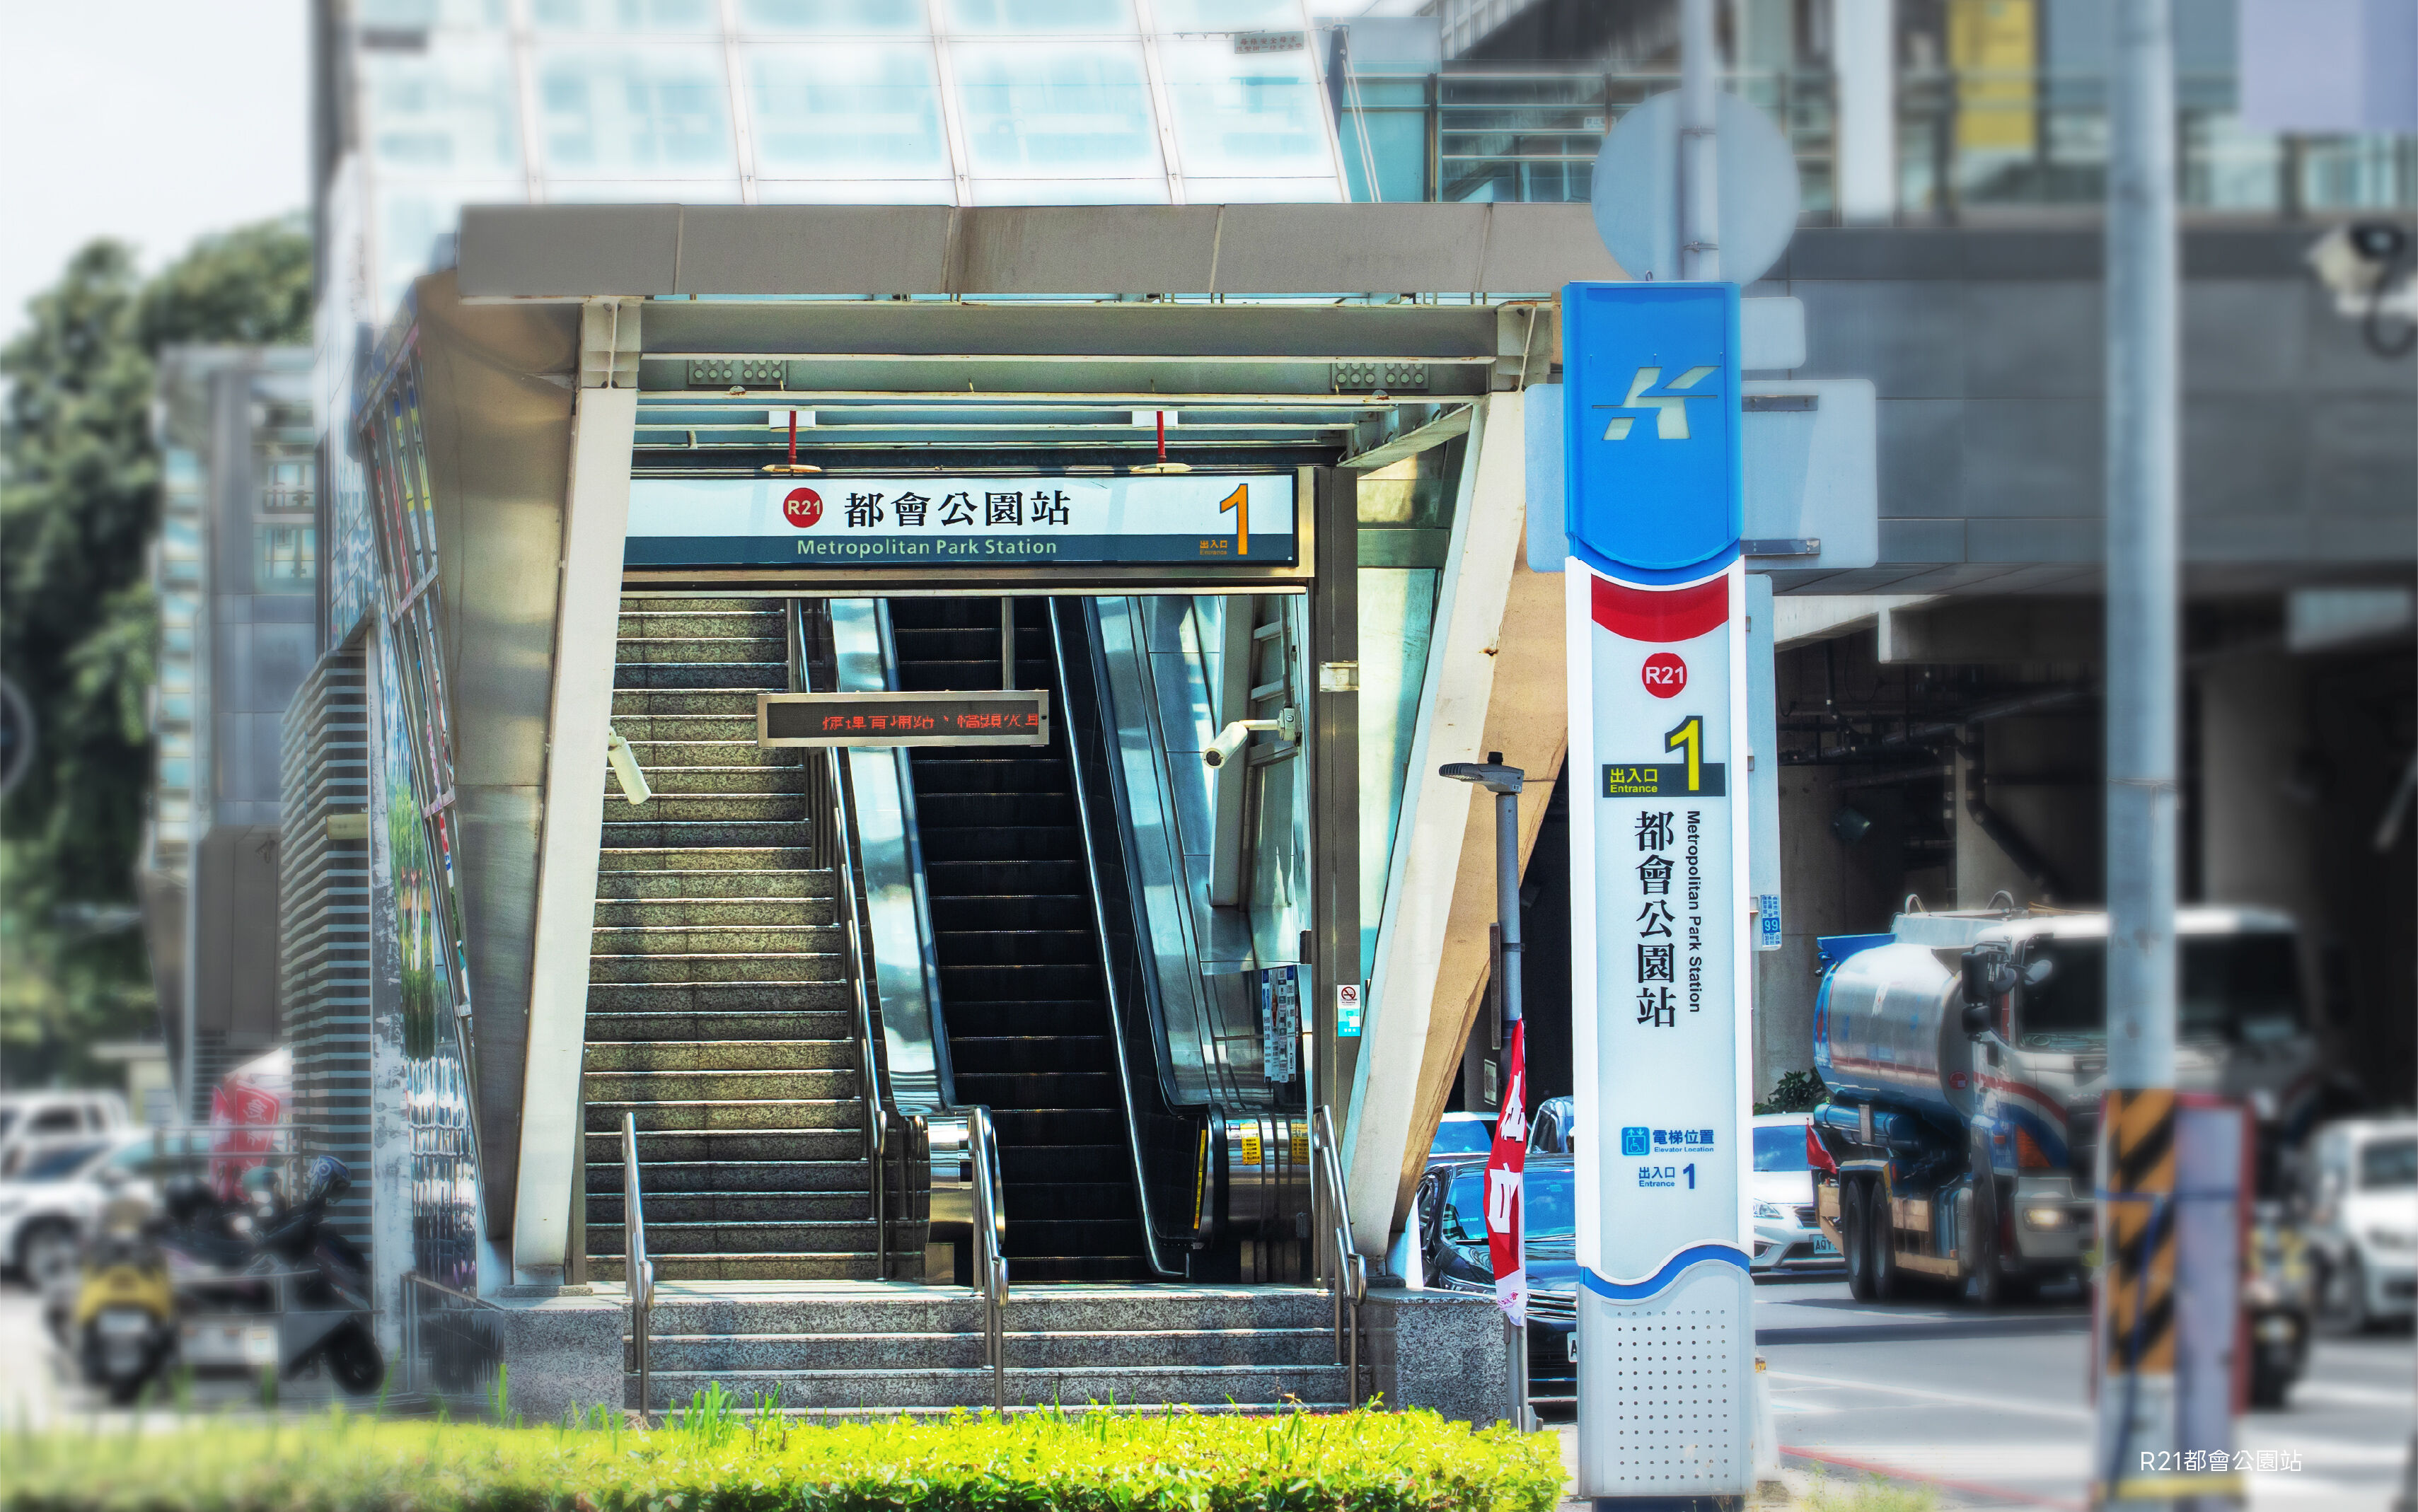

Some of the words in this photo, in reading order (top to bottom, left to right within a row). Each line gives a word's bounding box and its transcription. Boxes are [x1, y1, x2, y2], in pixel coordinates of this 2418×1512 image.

[787, 500, 821, 515] R21
[844, 489, 1071, 528] 都會公園站
[1220, 483, 1249, 555] 1
[797, 538, 930, 558] Metropolitan
[937, 537, 979, 554] Park
[985, 538, 1057, 554] Station
[1200, 540, 1227, 549] 出入口
[1645, 666, 1684, 684] R21
[1670, 719, 1699, 791] 1
[1610, 768, 1658, 783] 出入口
[1686, 810, 1701, 910] Metropolitan
[1634, 810, 1677, 1028] 都會公園站
[1689, 916, 1702, 951] Park
[1689, 956, 1702, 1013] Station
[1653, 1129, 1714, 1145] 電梯位置
[1638, 1167, 1675, 1180] 出入口
[1683, 1163, 1695, 1190] 1
[1815, 1239, 1837, 1251] AQY
